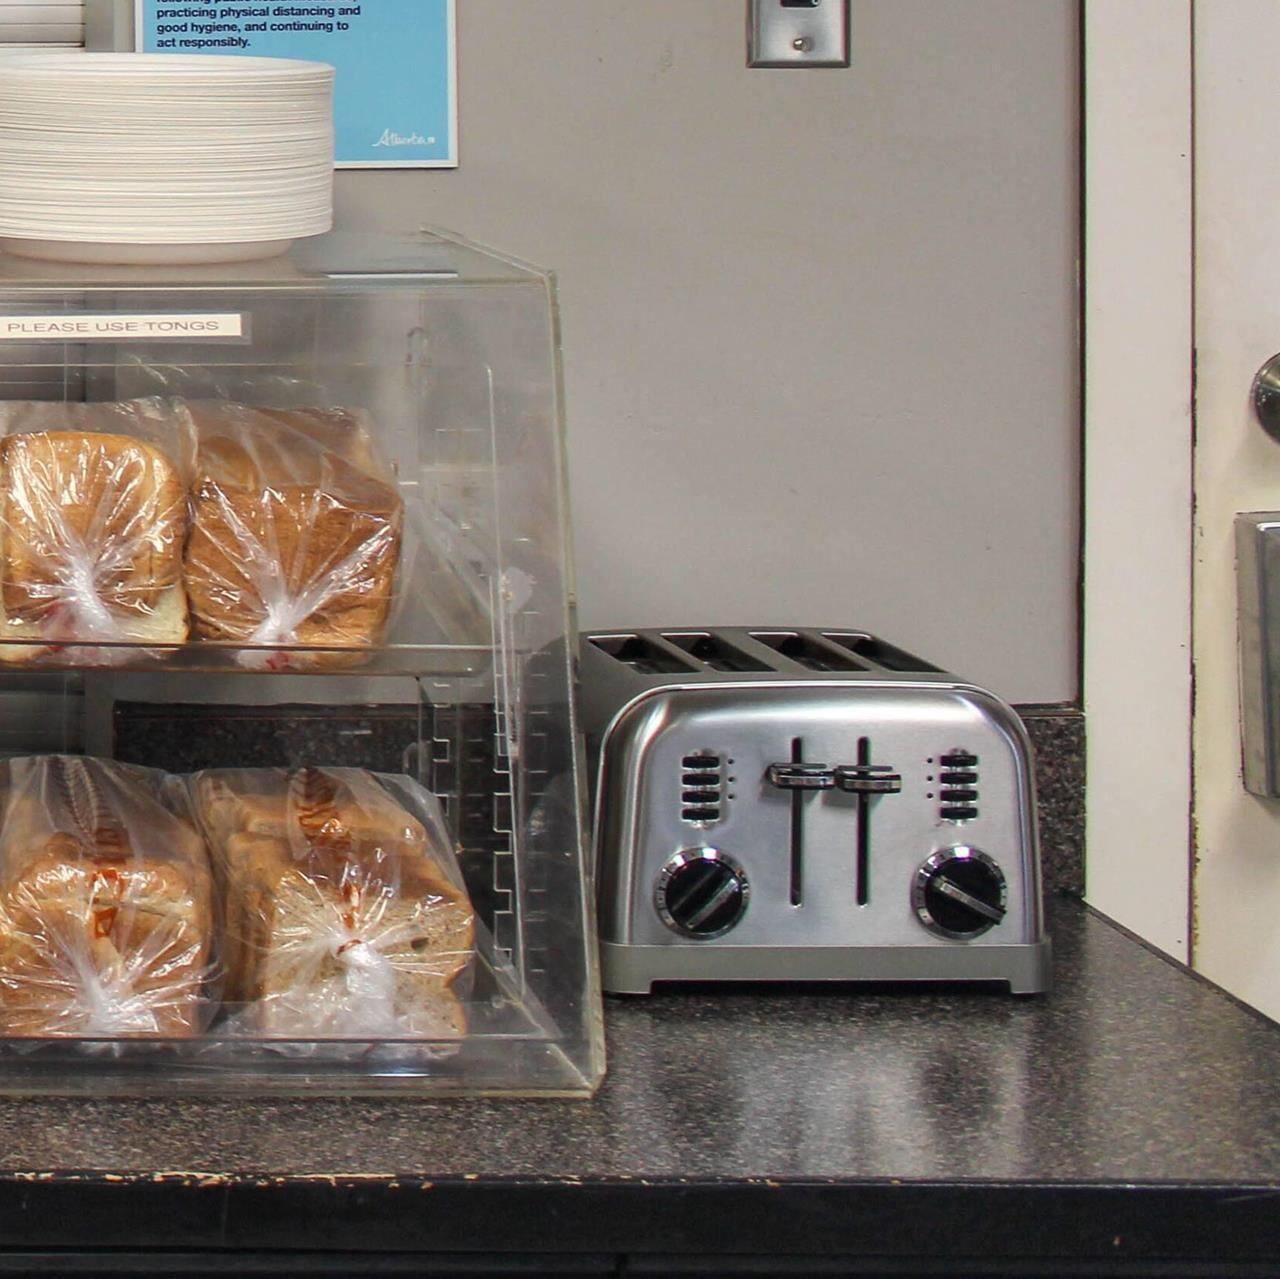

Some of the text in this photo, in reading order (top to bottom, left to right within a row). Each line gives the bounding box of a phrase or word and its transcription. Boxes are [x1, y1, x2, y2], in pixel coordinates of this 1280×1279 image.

[157, 4, 360, 18] practicing physical distancing and
[157, 20, 349, 34] good hygiene, and continuing to
[157, 37, 251, 49] act responsibly.
[8, 320, 220, 333] PLEASE USE TONGS
